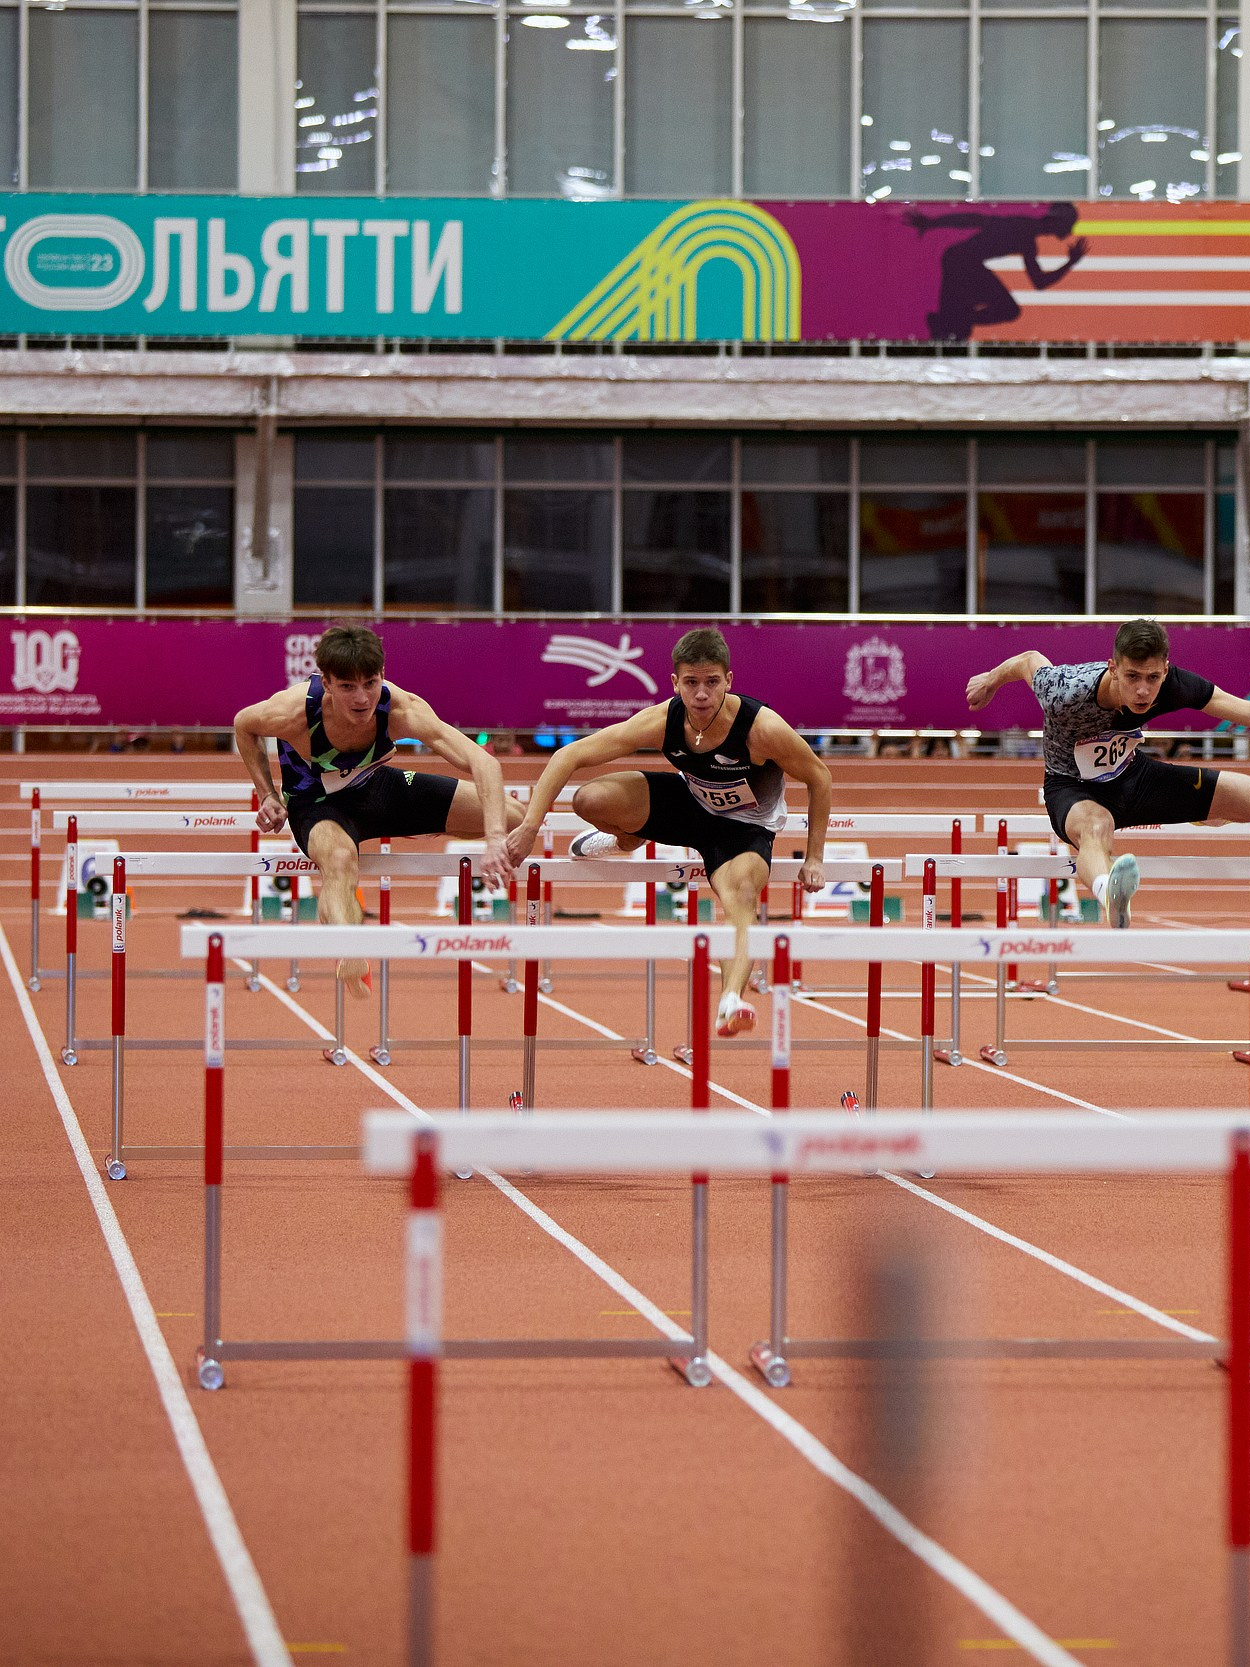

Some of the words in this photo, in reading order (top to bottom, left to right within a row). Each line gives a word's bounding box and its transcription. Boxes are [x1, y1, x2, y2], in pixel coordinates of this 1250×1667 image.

[0, 213, 464, 314] ОЛЬЯТТИ
[1094, 737, 1129, 768] 263
[194, 817, 237, 827] polanik
[827, 818, 855, 828] lanik
[276, 858, 320, 873] polan
[113, 909, 123, 942] polanik
[435, 935, 512, 956] polanik
[999, 937, 1074, 958] polanik
